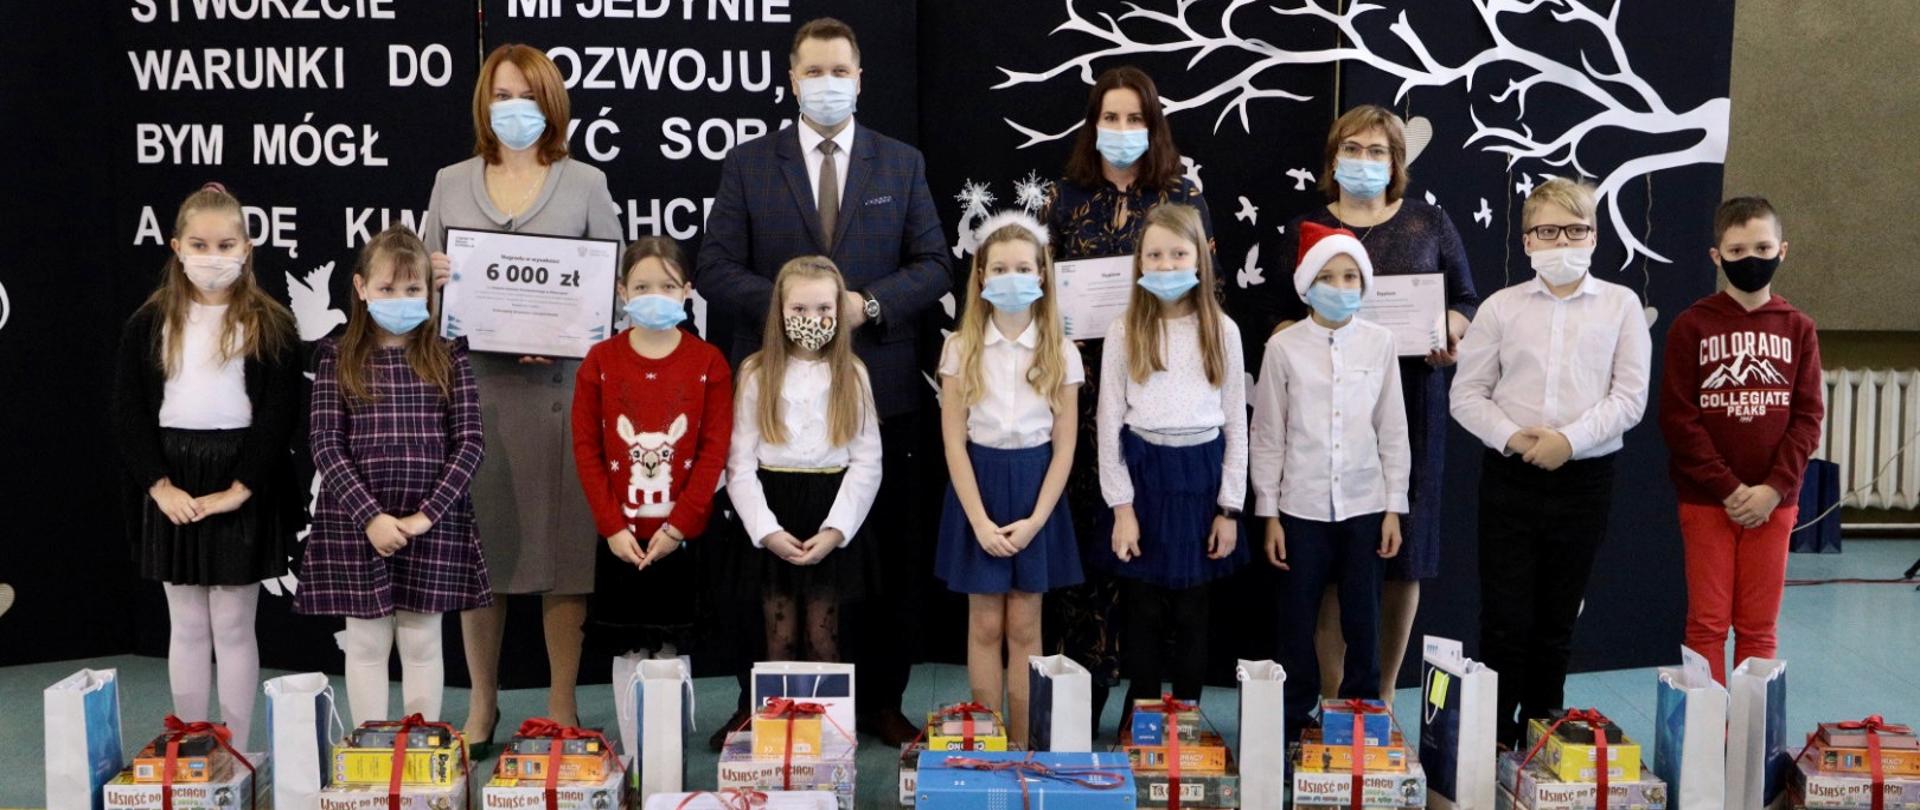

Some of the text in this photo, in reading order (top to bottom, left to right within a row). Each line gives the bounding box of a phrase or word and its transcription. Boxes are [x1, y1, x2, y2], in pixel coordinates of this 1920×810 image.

[128, 43, 785, 103] WARUNKI DO OZWOJU,
[136, 124, 223, 164] BYM
[253, 112, 388, 166] MÓGŁ
[133, 205, 164, 246] A
[486, 263, 580, 287] 6 000 zł
[1700, 331, 1792, 366] COLORADO
[1700, 391, 1790, 408] COLLEGIATE
[1727, 405, 1766, 417] PEAKS
[1337, 782, 1349, 791] DO
[1848, 785, 1860, 793] DO
[149, 793, 161, 803] DO
[359, 799, 371, 807] DO
[527, 796, 539, 804] DO
